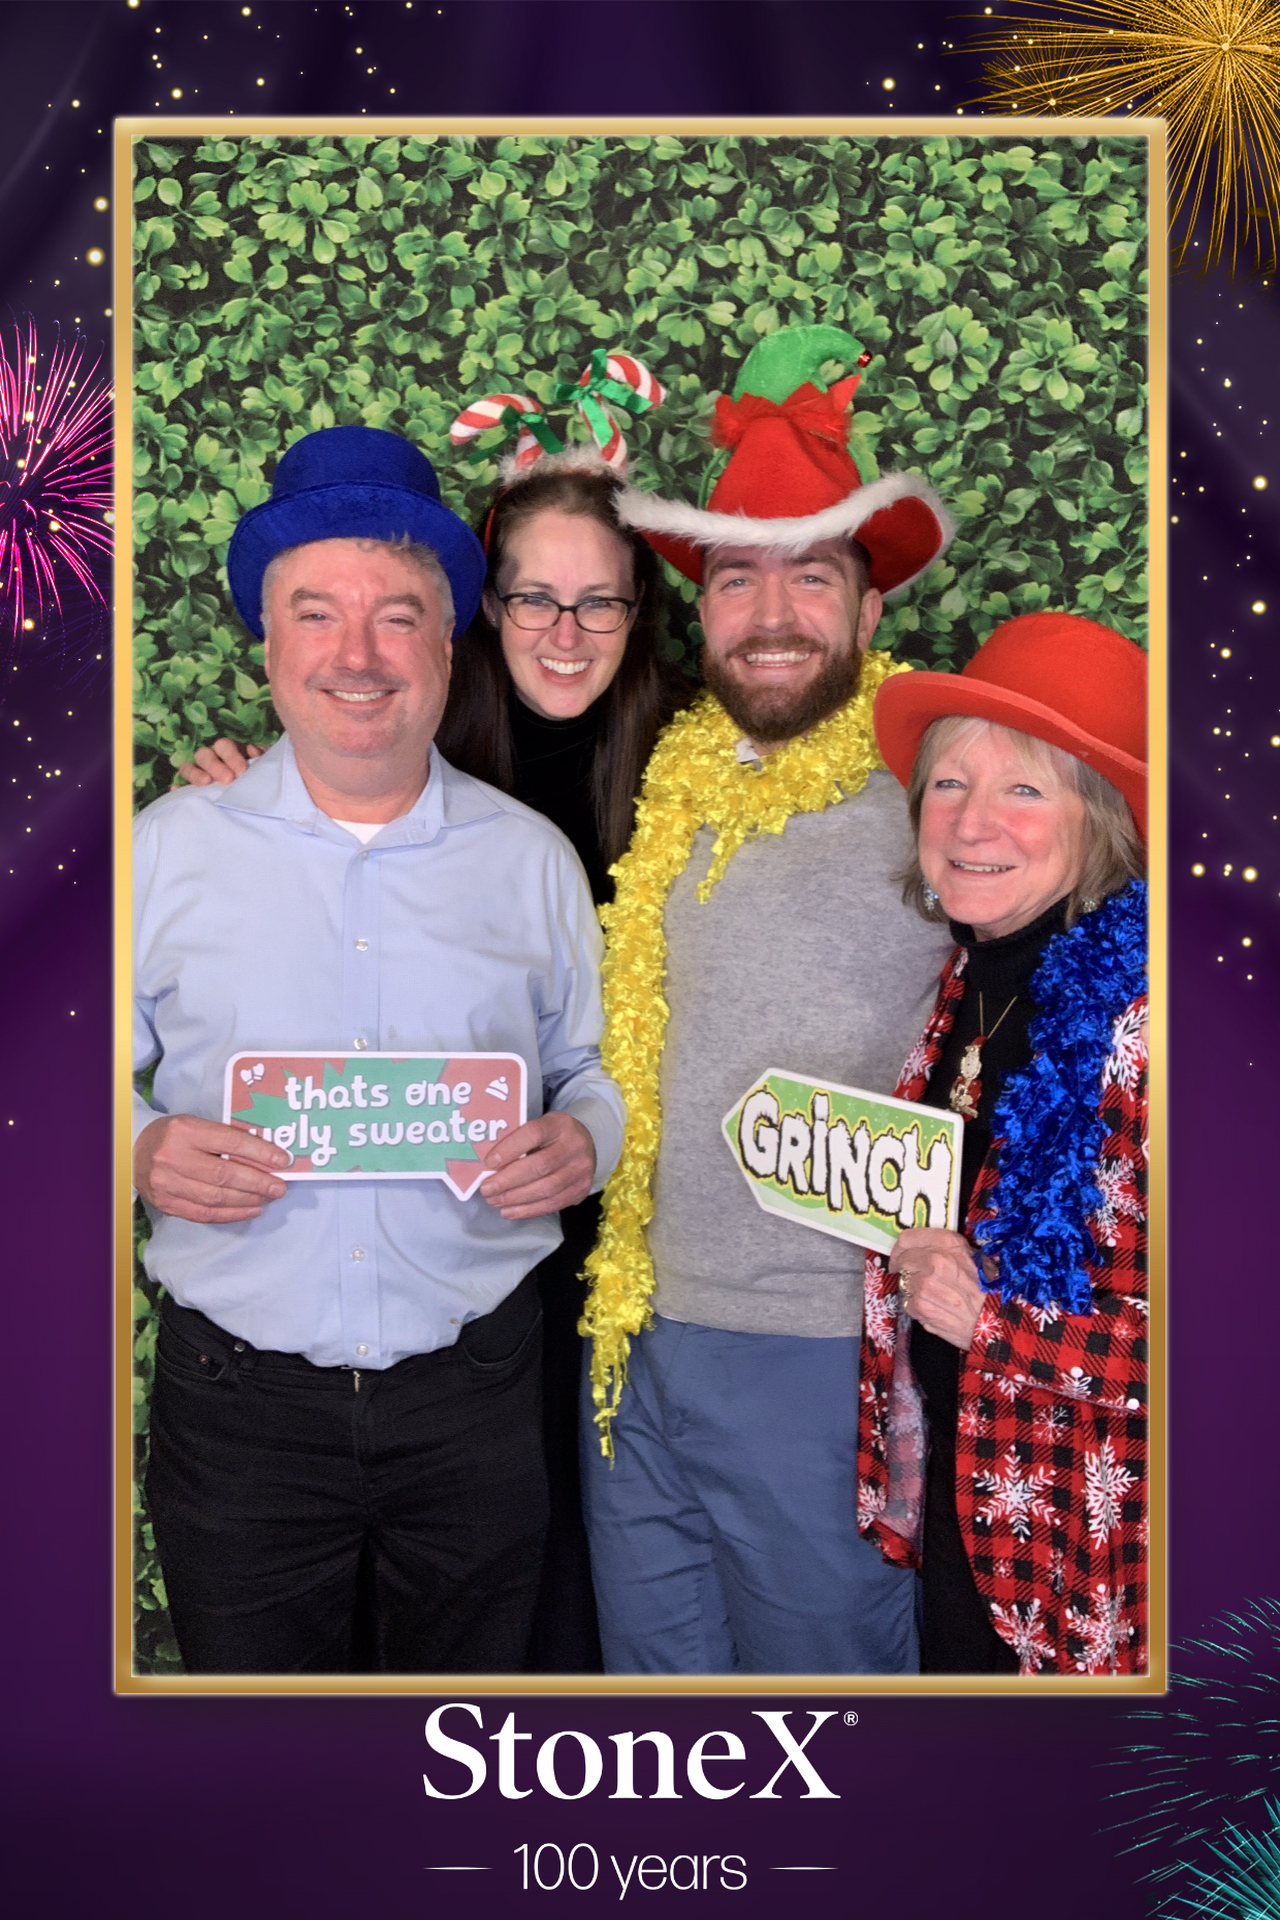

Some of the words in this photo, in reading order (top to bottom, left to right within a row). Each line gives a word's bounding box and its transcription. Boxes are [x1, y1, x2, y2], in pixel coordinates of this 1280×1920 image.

[285, 1075, 389, 1110] thats
[405, 1080, 472, 1106] one
[348, 1110, 508, 1147] sweater
[739, 1085, 953, 1230] GRINCH
